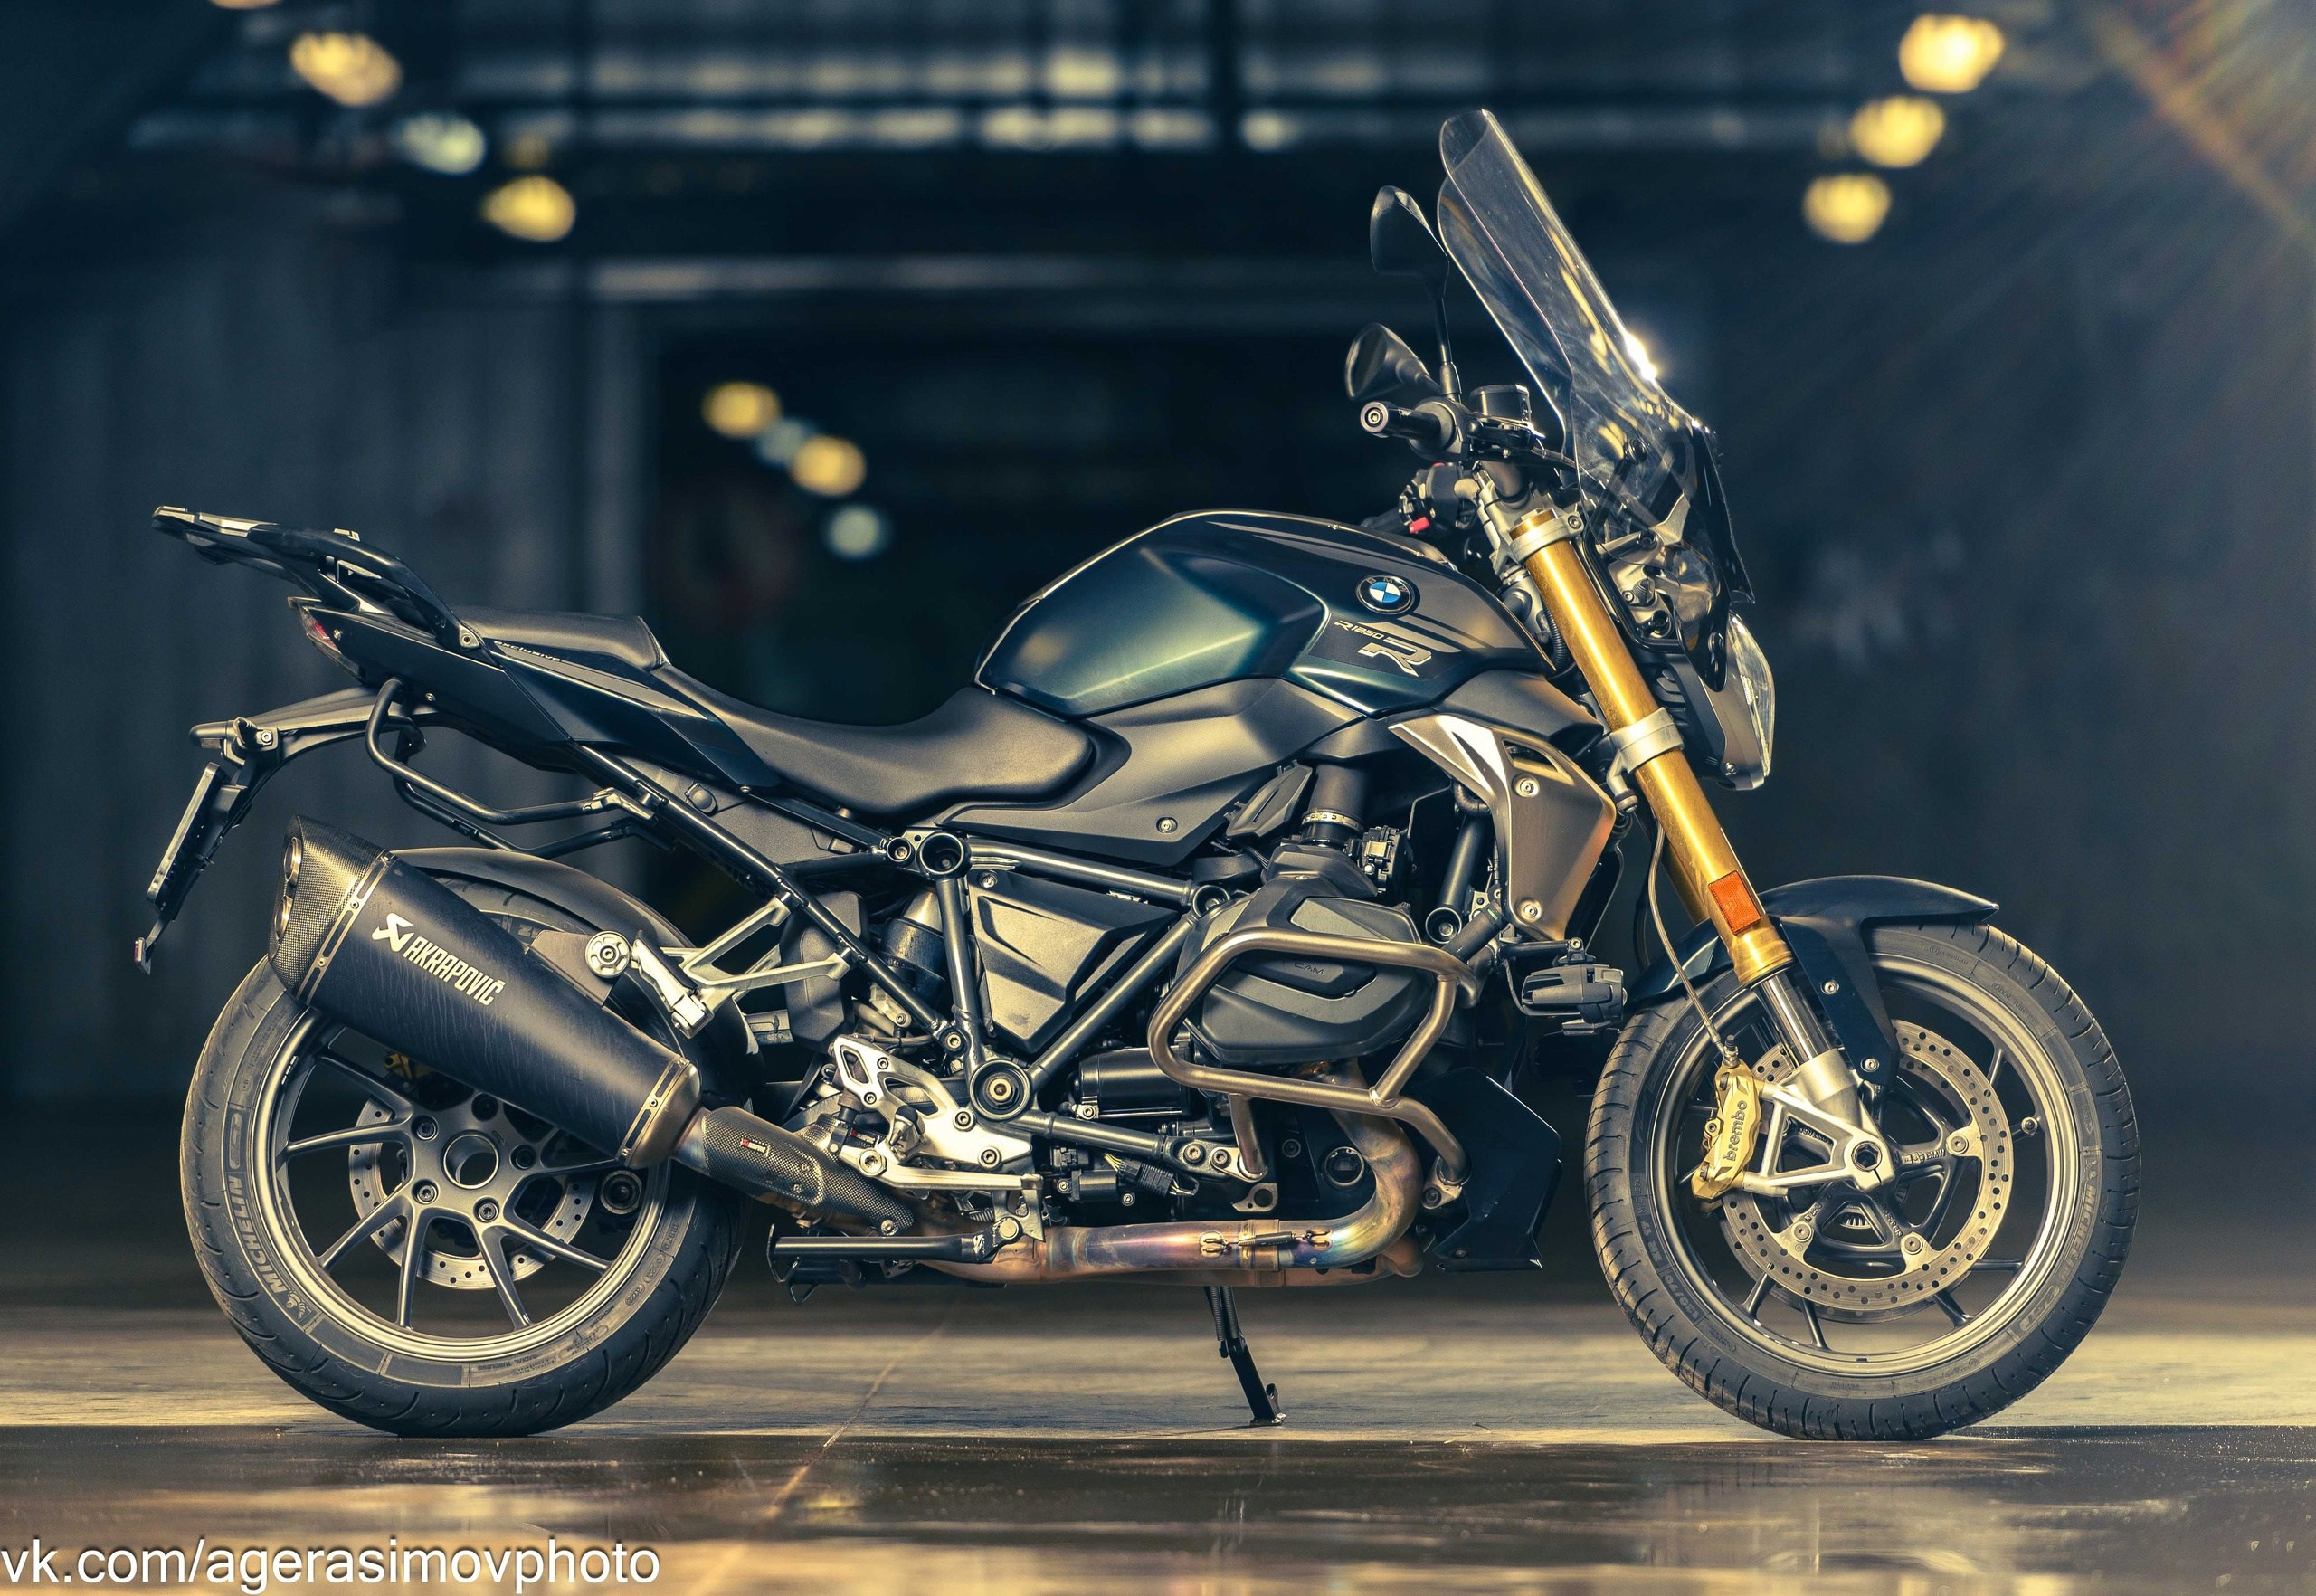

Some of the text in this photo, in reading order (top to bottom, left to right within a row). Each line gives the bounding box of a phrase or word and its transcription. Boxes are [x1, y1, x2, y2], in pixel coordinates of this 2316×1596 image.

[494, 641, 561, 661] exclusive
[1357, 636, 1431, 677] R
[1723, 1100, 1748, 1161] brembo
[228, 1174, 287, 1294] MICHELIN
[1641, 1219, 1654, 1236] 17
[2055, 1183, 2098, 1284] MICHELIN
[1647, 1240, 1664, 1262] ZR
[1663, 1272, 1701, 1320] 120/70
